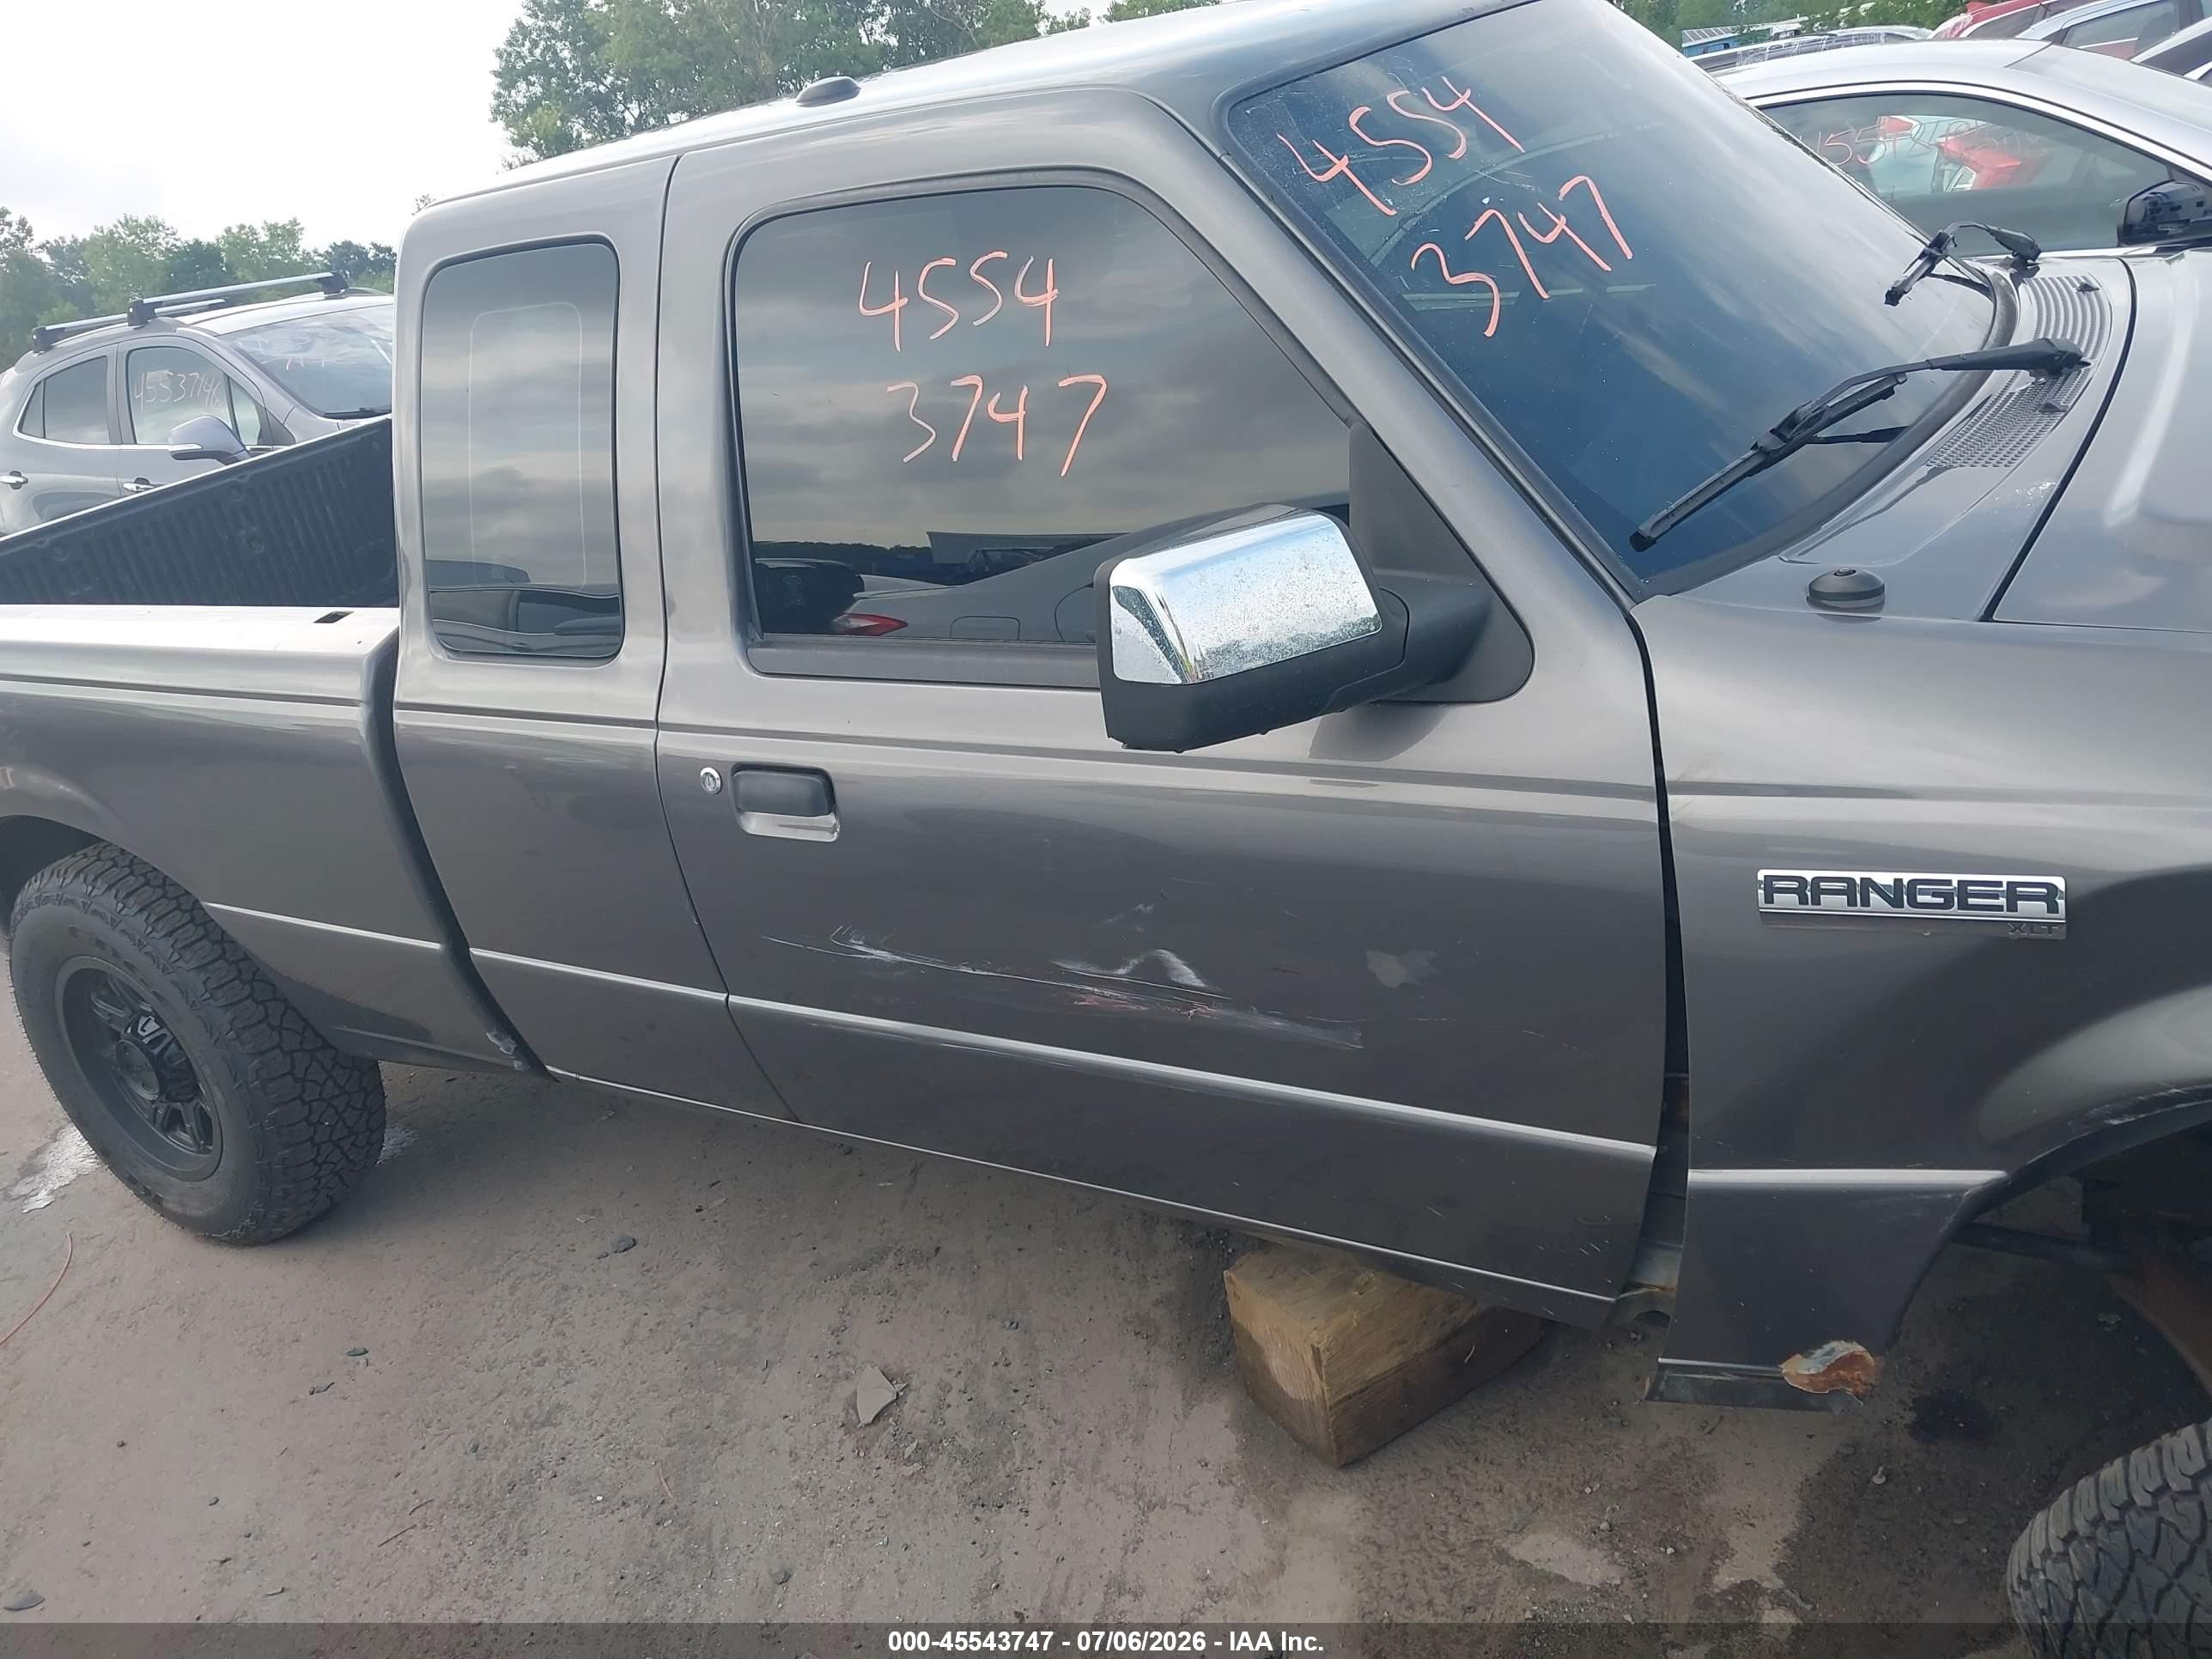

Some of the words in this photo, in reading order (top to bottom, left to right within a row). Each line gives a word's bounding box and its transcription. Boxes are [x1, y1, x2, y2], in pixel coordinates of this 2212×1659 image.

[1276, 76, 1525, 216] 4554
[859, 250, 1059, 352] 4554
[1411, 174, 1633, 337] 3747
[885, 374, 1107, 477] 3747
[1763, 874, 2060, 915] RANGER
[2007, 922, 2060, 936] XLT
